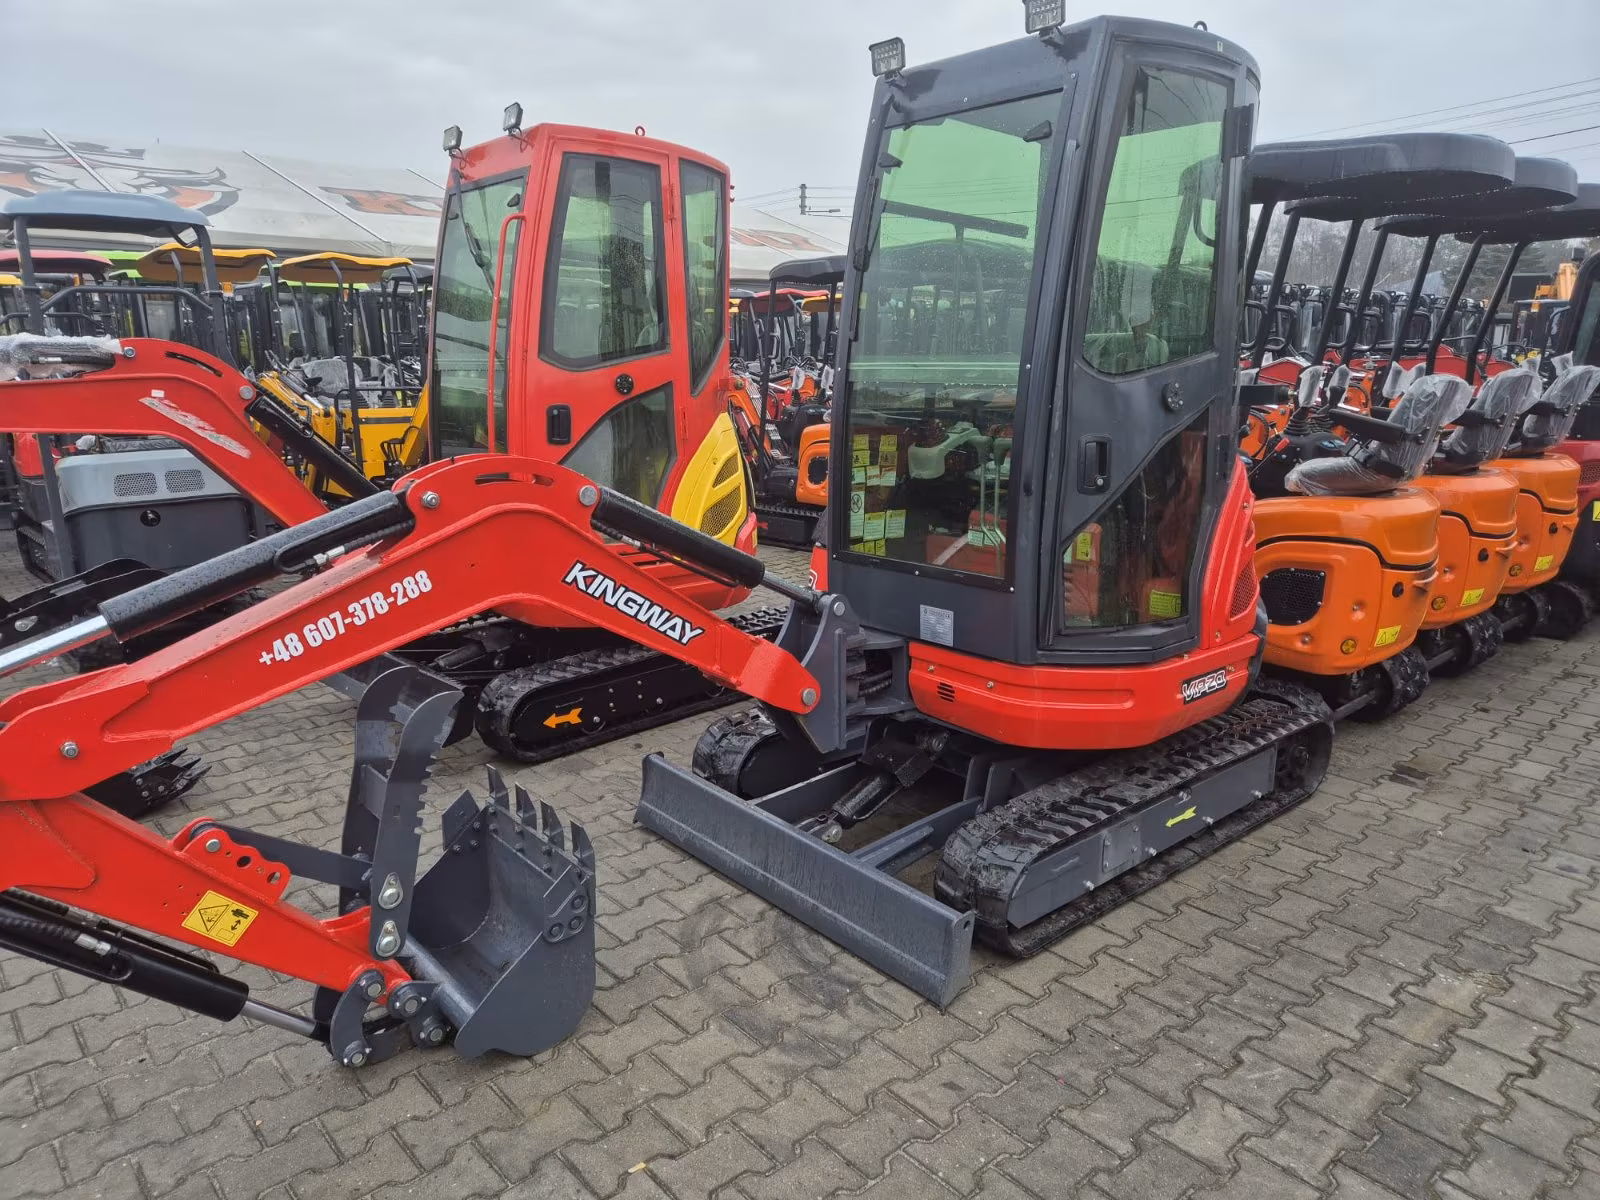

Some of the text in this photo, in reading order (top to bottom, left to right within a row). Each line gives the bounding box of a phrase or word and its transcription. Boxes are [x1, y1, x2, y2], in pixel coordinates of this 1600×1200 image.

[259, 570, 432, 665] +48 607-378-288
[564, 561, 704, 645] KINGWAY
